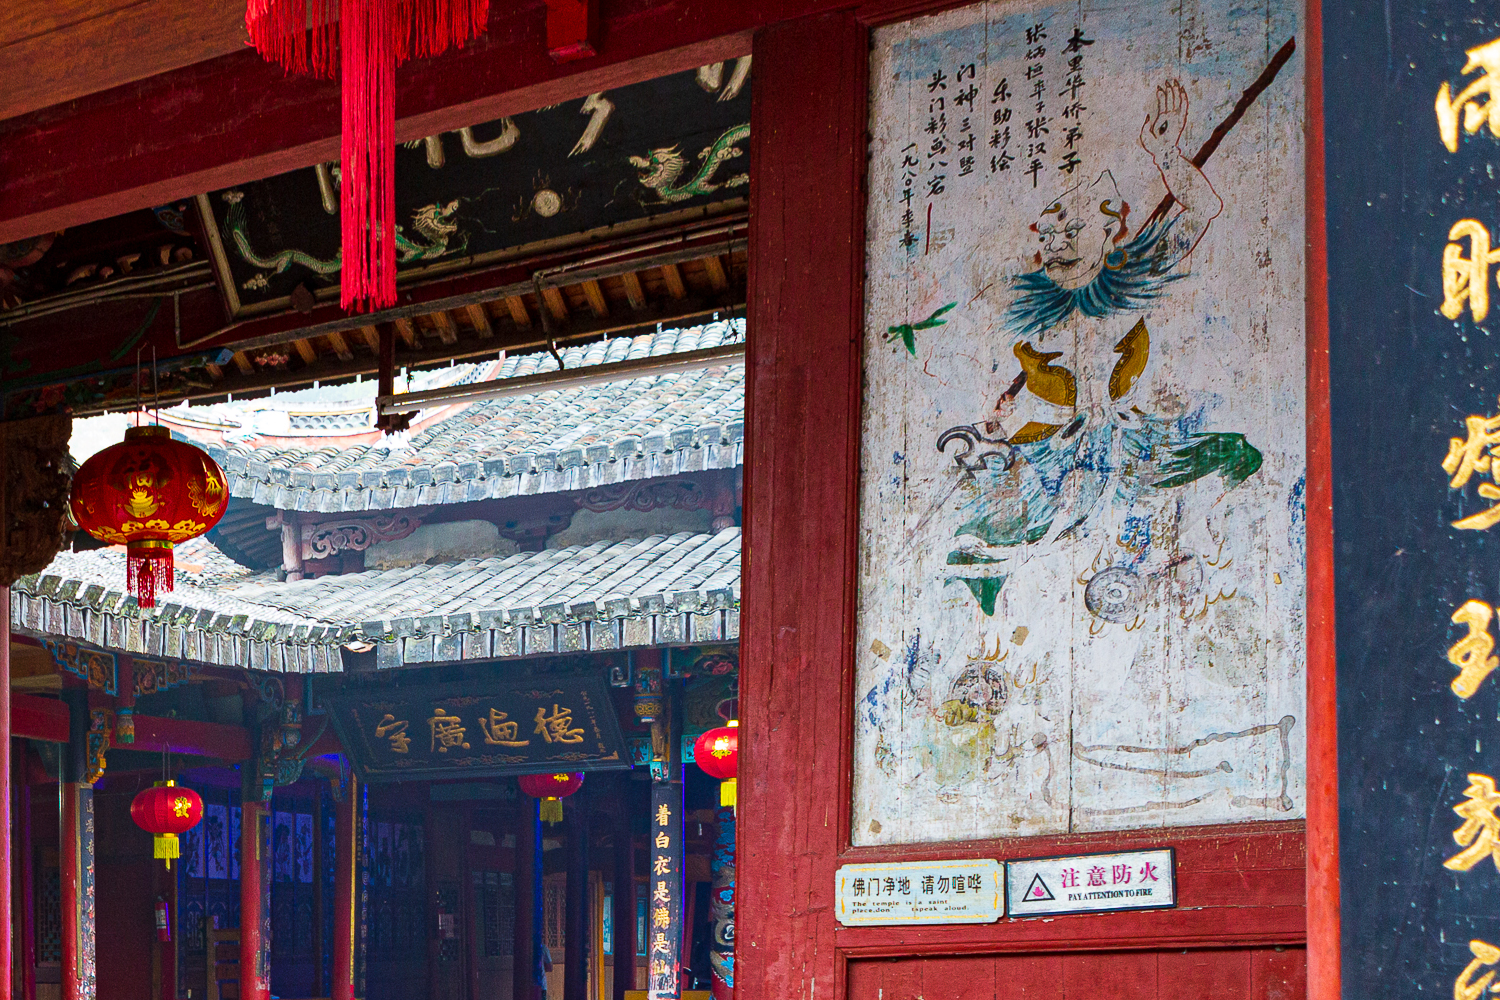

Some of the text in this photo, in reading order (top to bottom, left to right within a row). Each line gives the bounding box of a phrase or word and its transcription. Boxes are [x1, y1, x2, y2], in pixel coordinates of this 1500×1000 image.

[953, 62, 979, 177] 门神三对暨
[989, 77, 1015, 174] 乐助彩绘
[1057, 28, 1095, 174] 本里华侨弟子
[851, 873, 983, 898] 佛门净地 请勿喧哗
[1060, 861, 1160, 889] 注意防火
[1068, 887, 1153, 902] PAY ATTENTION TO FIRE
